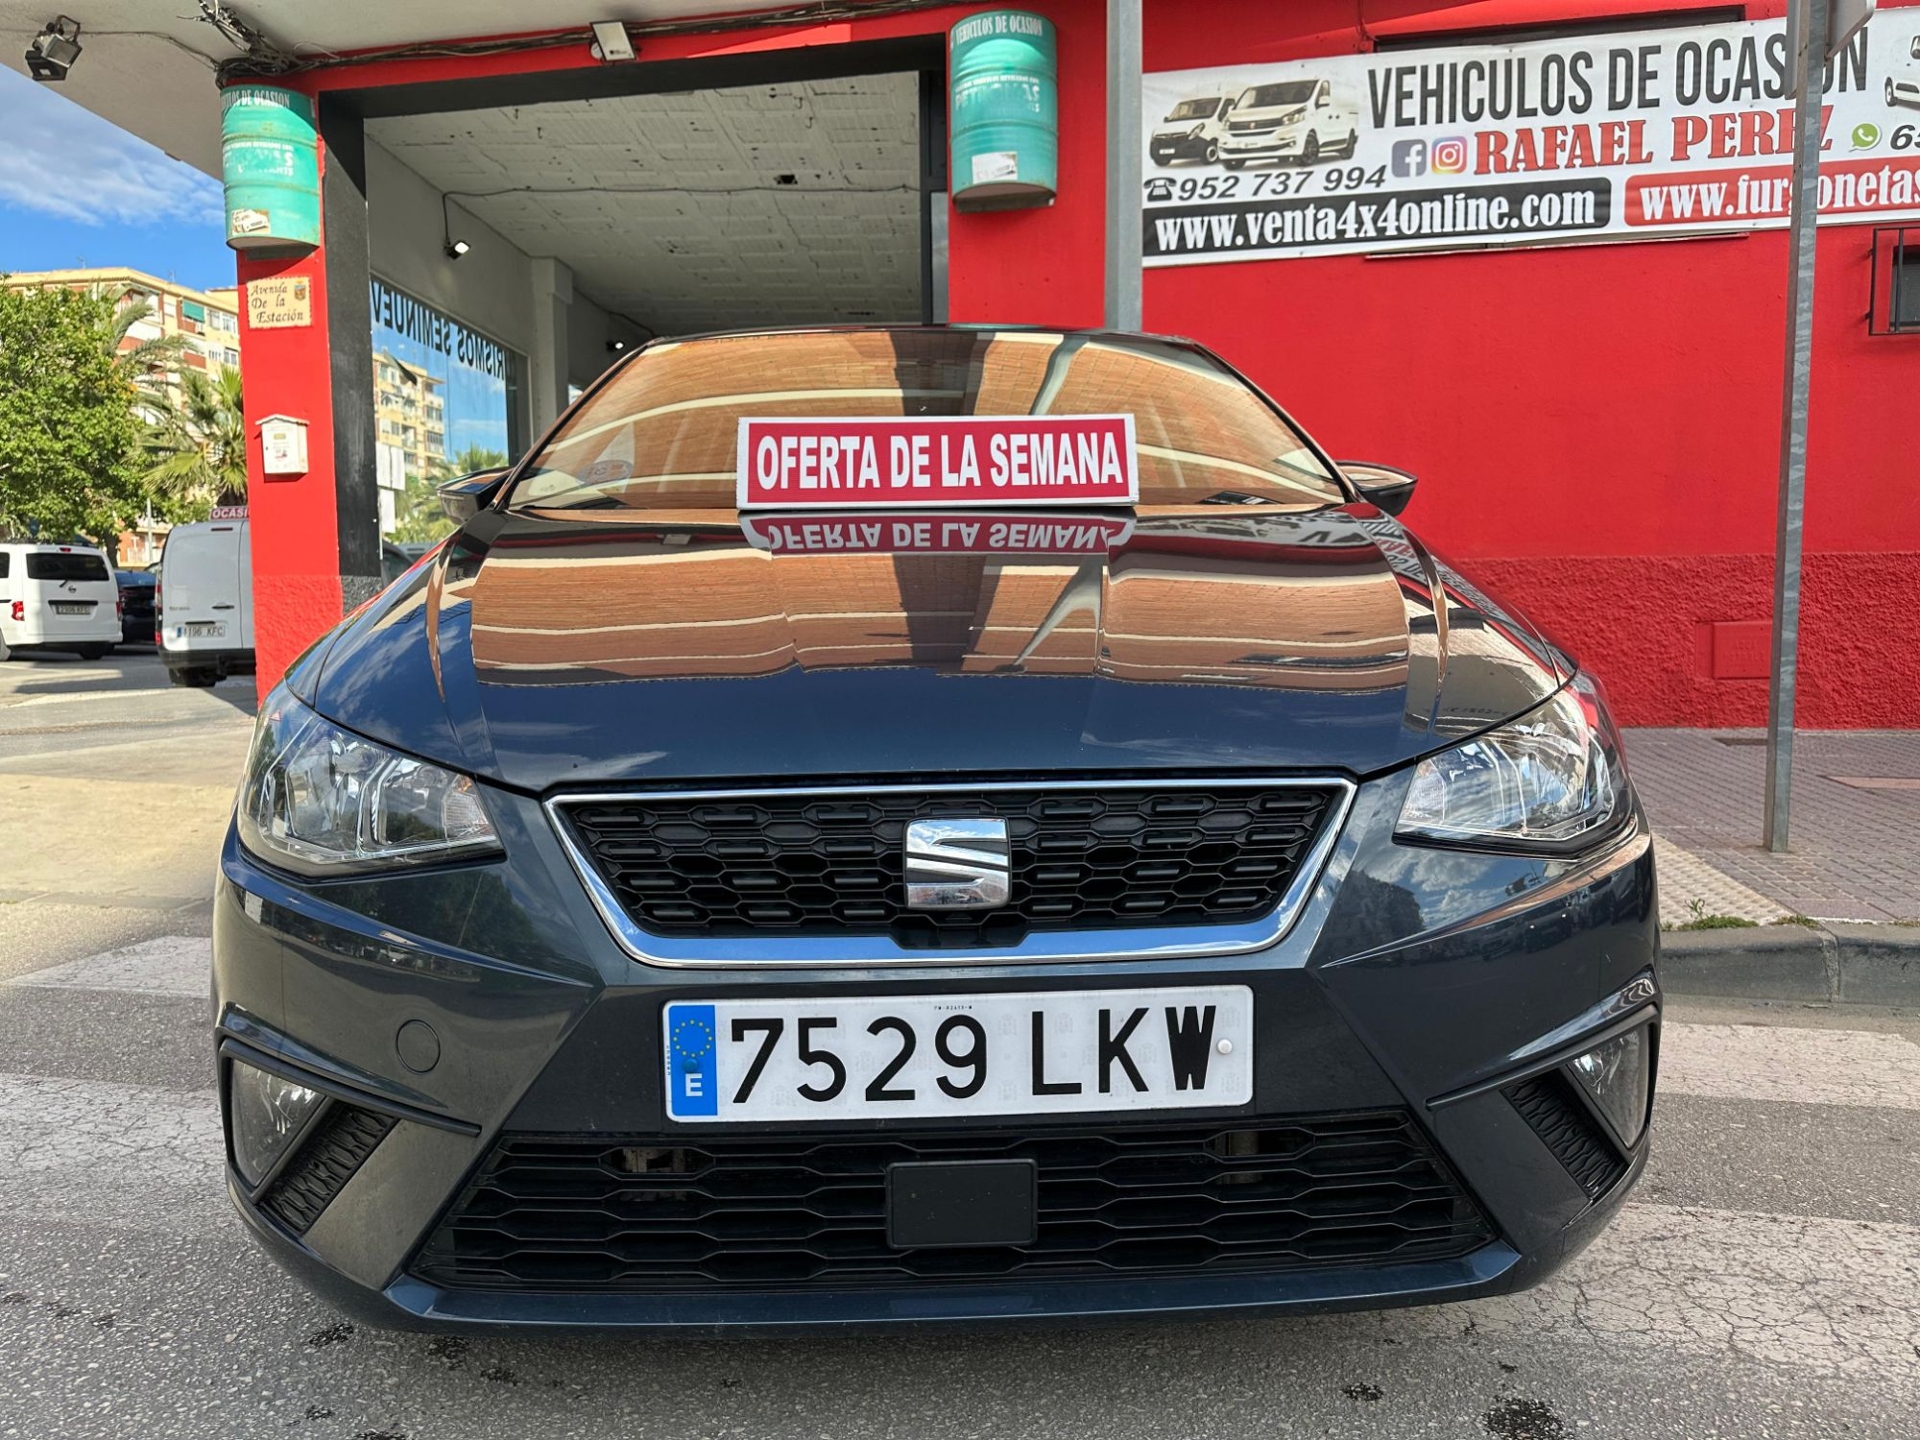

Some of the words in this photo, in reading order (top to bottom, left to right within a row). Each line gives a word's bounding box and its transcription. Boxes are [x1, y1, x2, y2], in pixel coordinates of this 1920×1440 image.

[995, 15, 1008, 34] DE
[241, 89, 252, 106] DE
[1367, 51, 1594, 129] VEHICULOS
[1607, 44, 1662, 111] DE
[1675, 26, 1869, 106] OCASN
[1473, 119, 1654, 176] RAFAEL
[1177, 174, 1240, 201] 952
[1251, 170, 1315, 196] 737
[1323, 164, 1387, 192] 994
[1639, 164, 1920, 222] www.furoneta
[1154, 188, 1596, 252] www.venta4x4online.com
[250, 281, 288, 297] Avenida
[251, 297, 267, 309] De
[275, 294, 285, 307] la
[256, 308, 304, 324] Estación
[756, 434, 881, 491] OFERTA
[889, 434, 931, 489] DE
[940, 433, 982, 488] LA
[989, 431, 1123, 487] SEMANA
[684, 1072, 704, 1097] E
[730, 1013, 987, 1104] 7529
[1031, 1004, 1217, 1096] LKW
